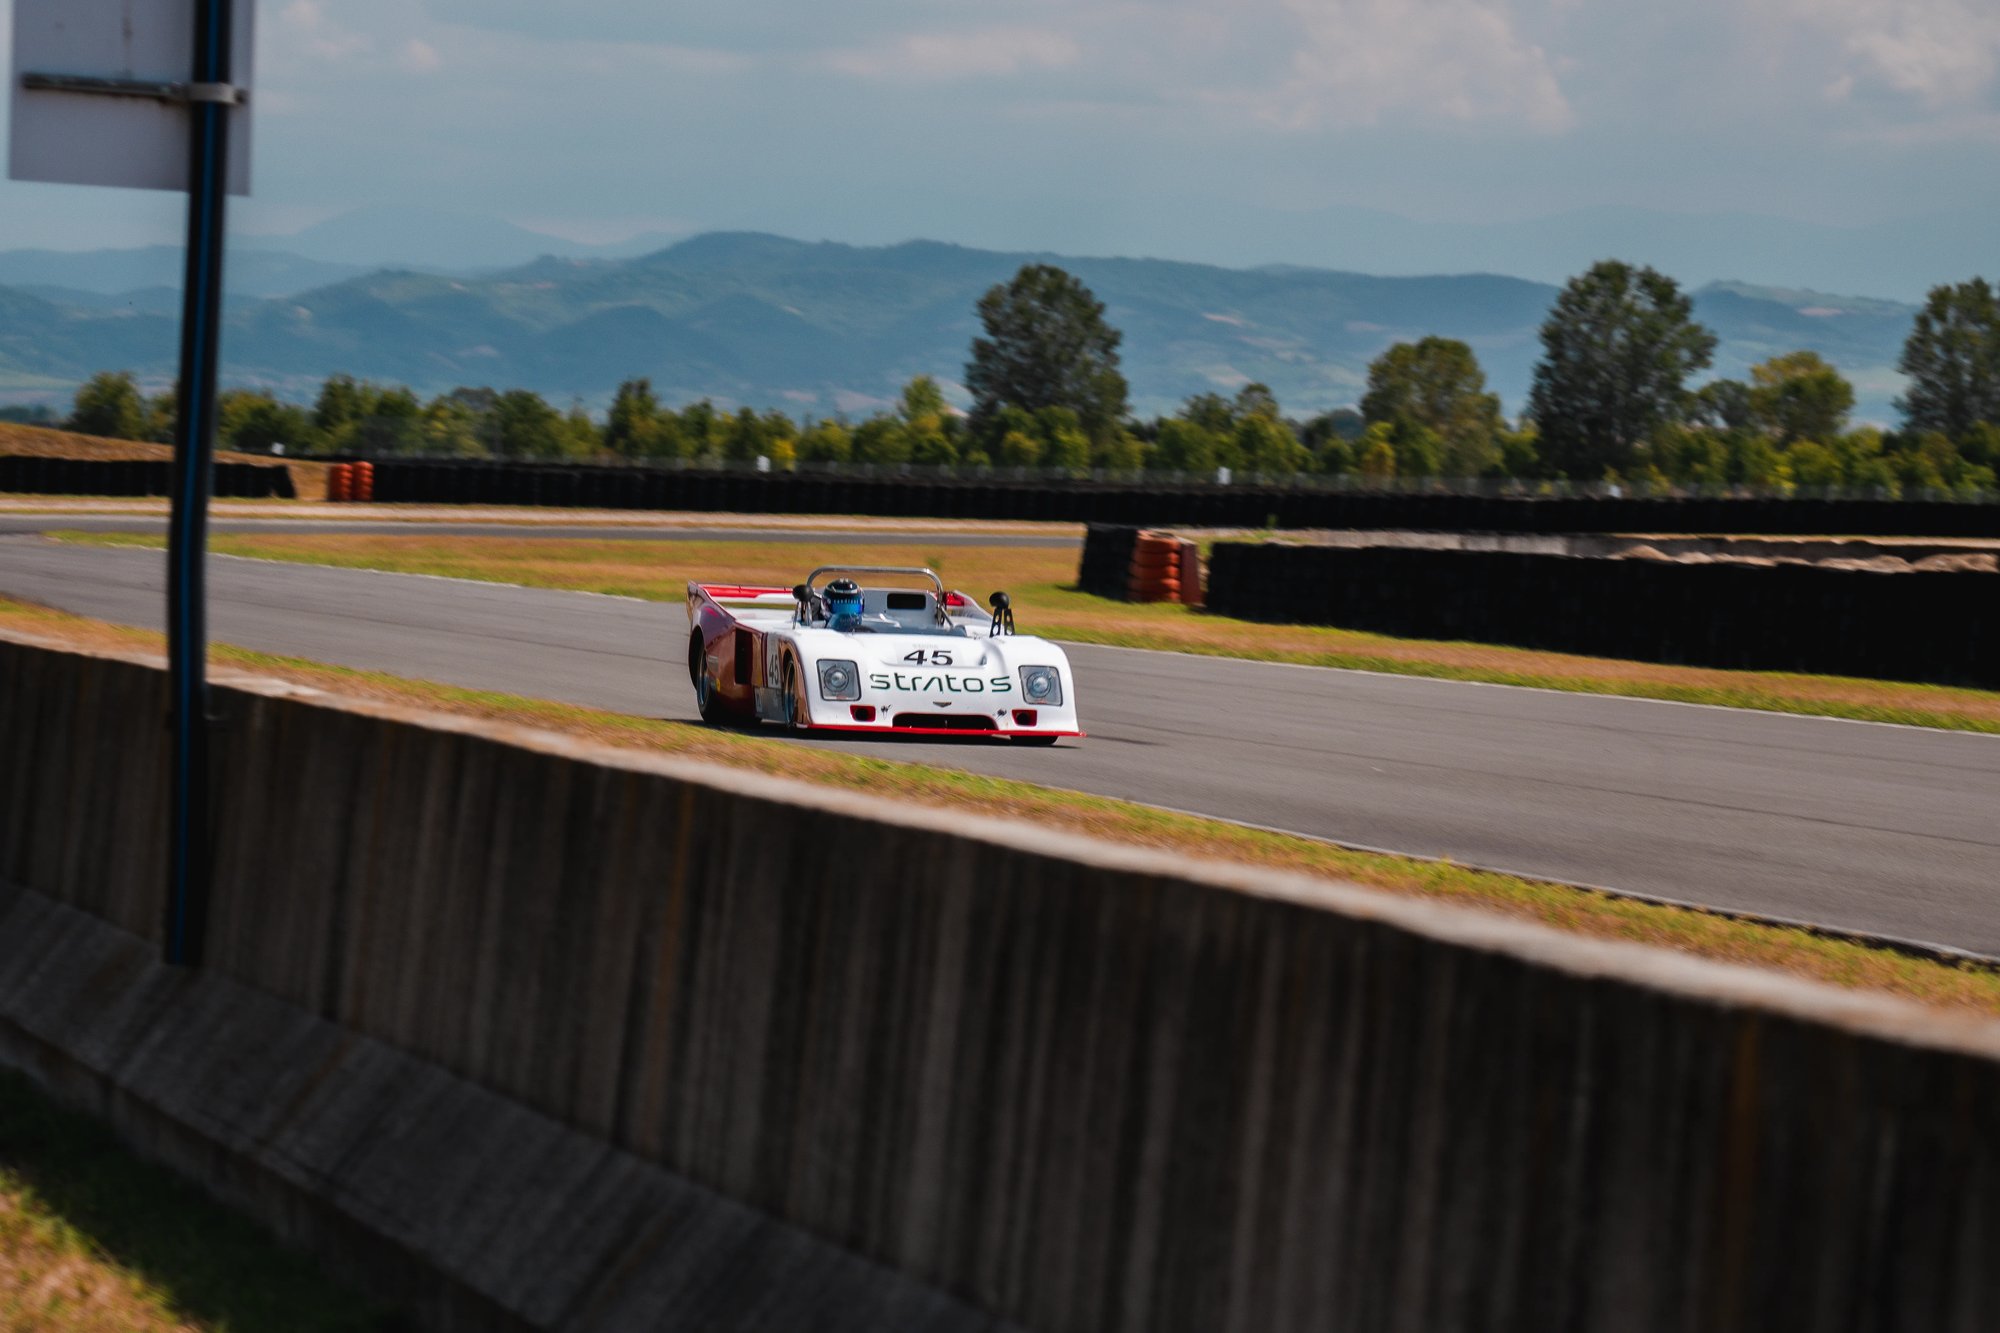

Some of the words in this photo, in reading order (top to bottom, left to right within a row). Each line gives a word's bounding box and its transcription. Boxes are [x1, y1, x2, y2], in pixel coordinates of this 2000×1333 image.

[903, 649, 953, 666] 45
[769, 654, 779, 685] 45
[870, 672, 1012, 693] stratos
